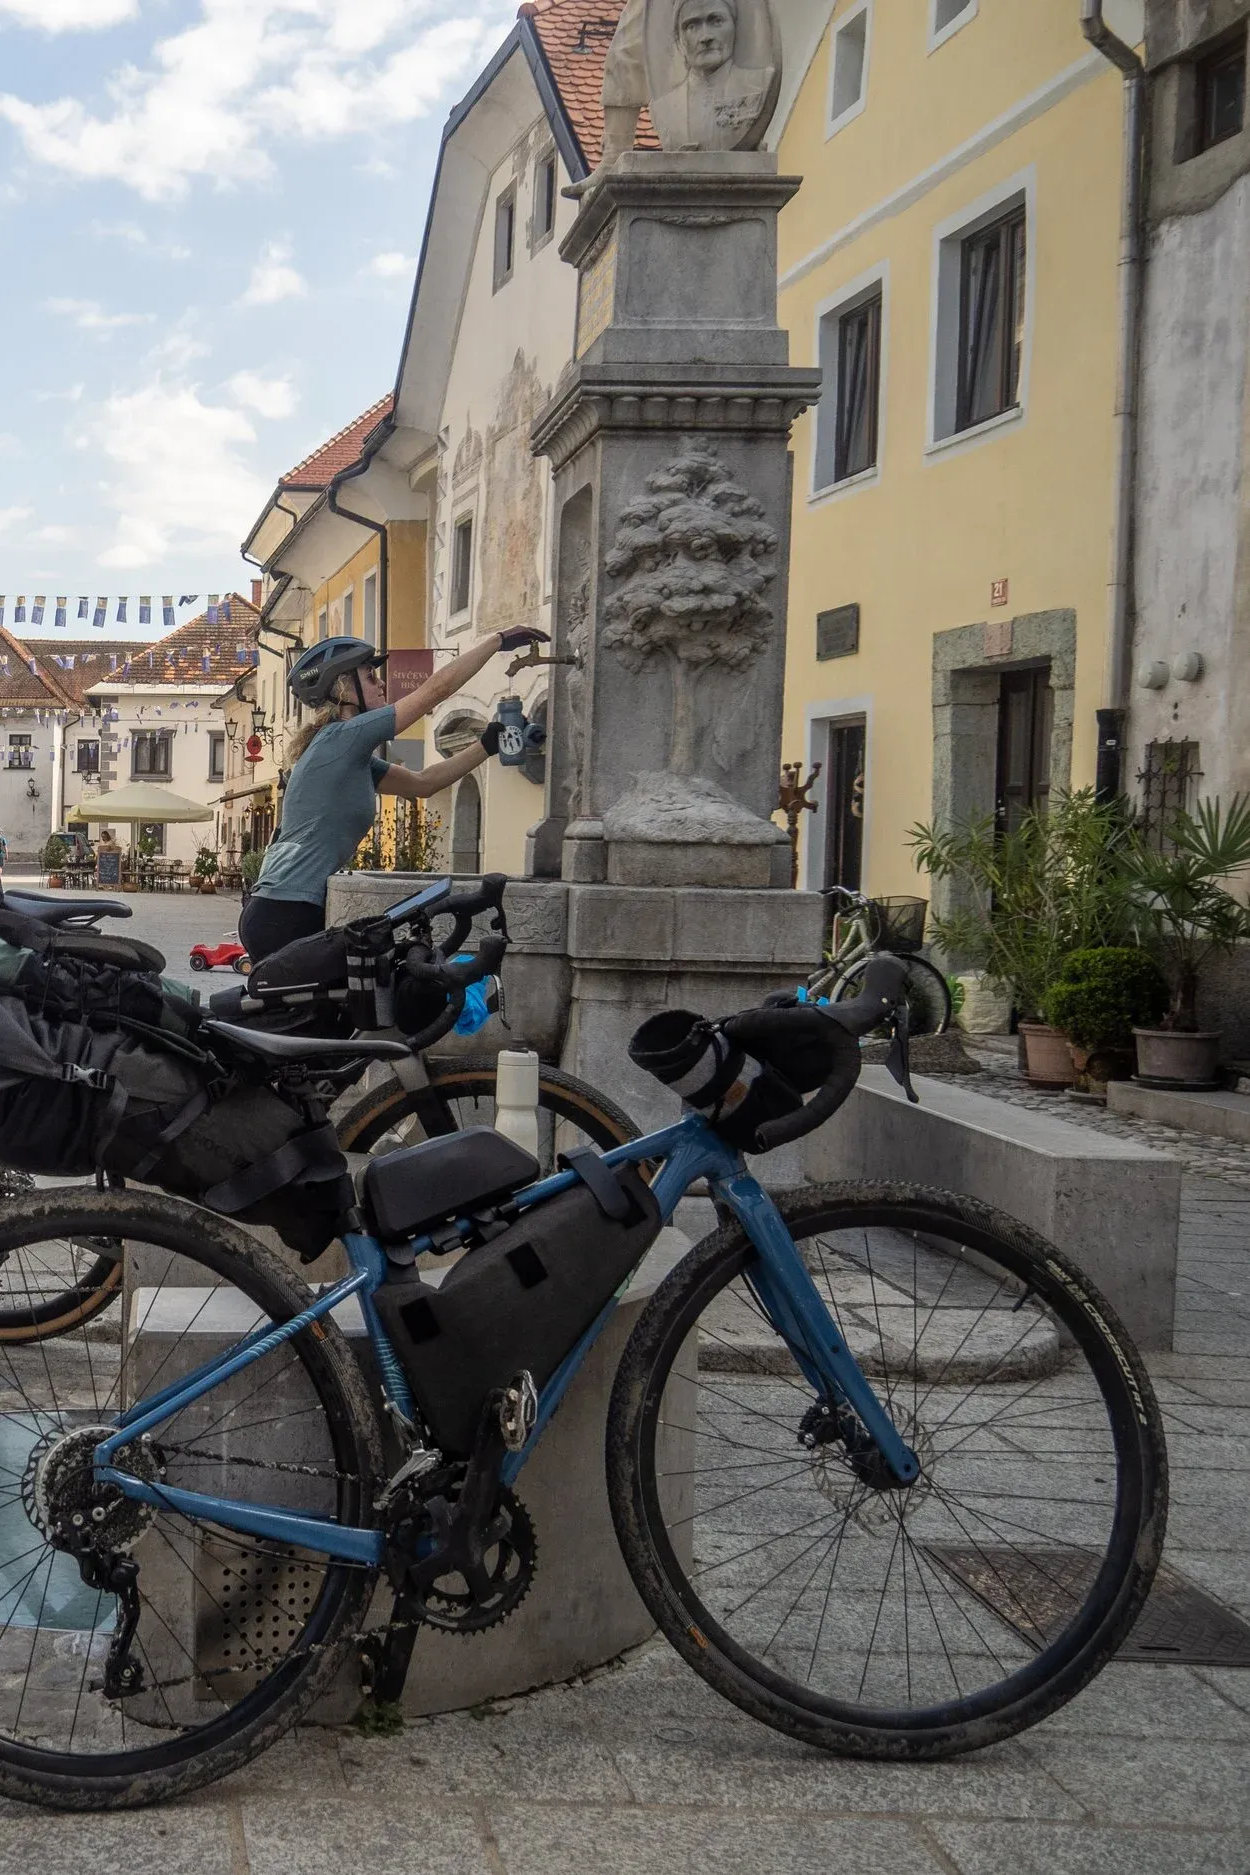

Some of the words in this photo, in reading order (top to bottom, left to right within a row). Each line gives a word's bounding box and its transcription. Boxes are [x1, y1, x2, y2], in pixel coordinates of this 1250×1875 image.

[993, 582, 1003, 597] 21
[300, 667, 319, 680] SMITH
[1084, 1302, 1139, 1392] CROSSCUT
[1132, 1391, 1144, 1412] AT
